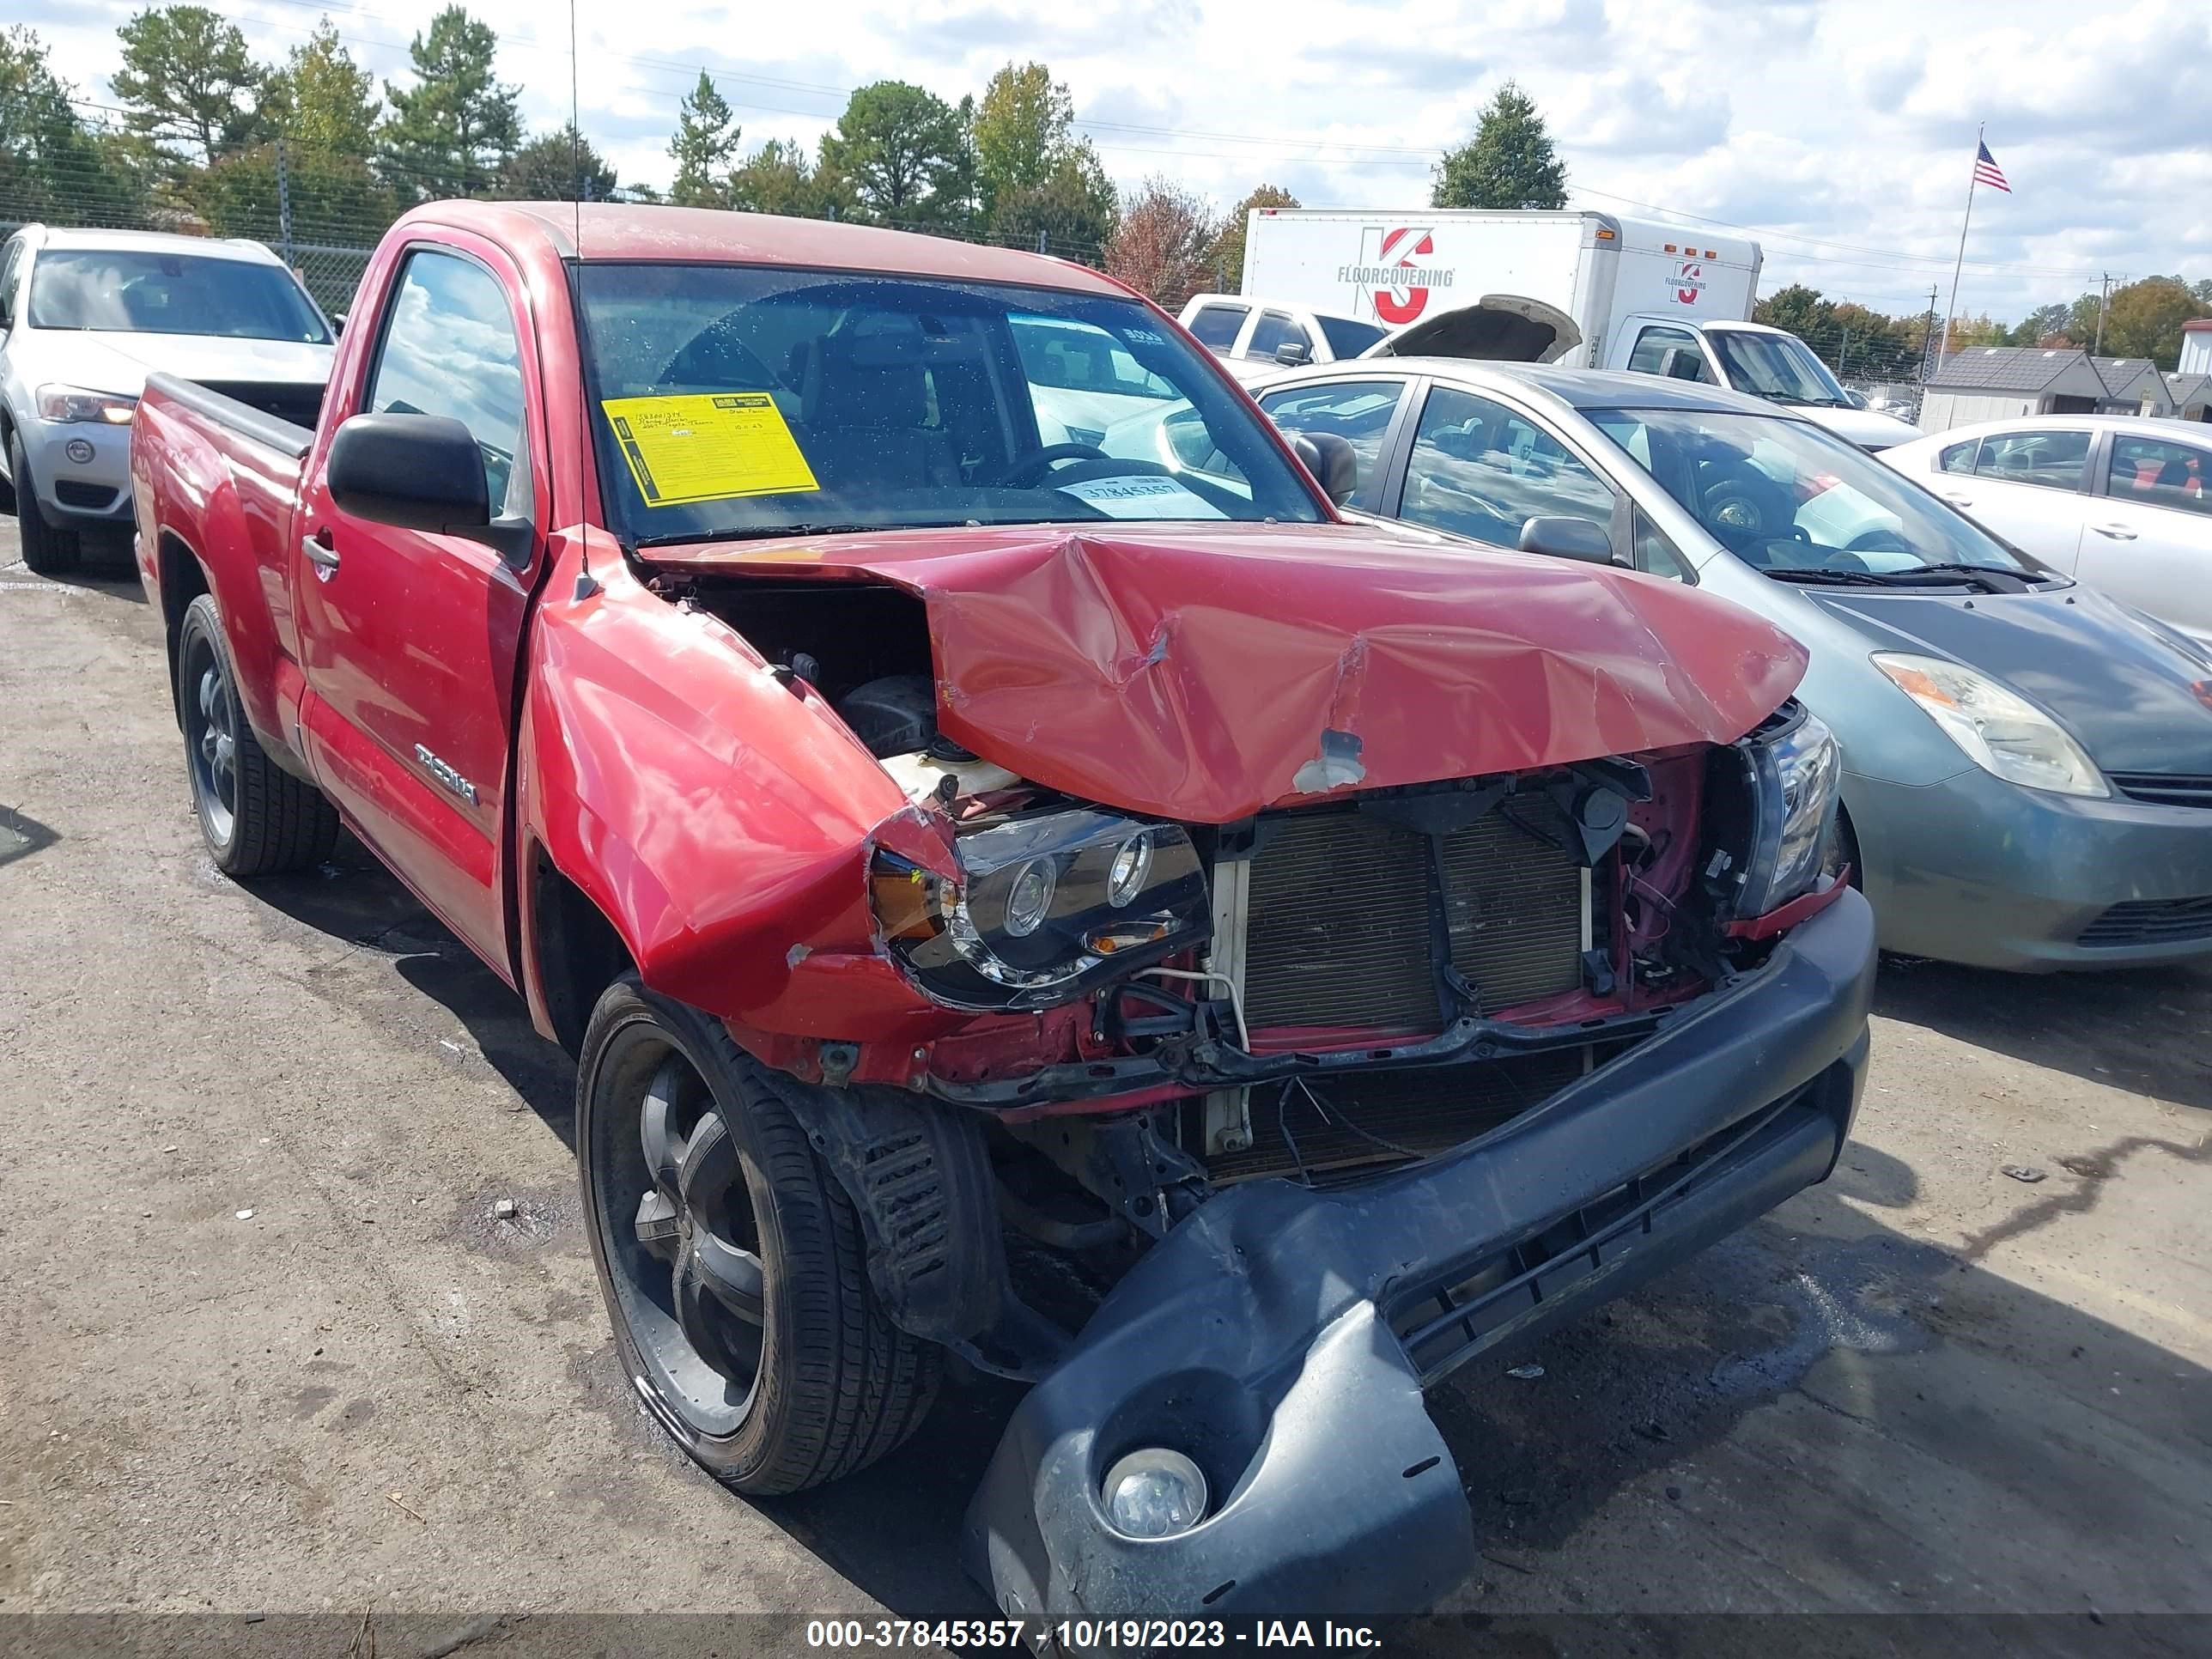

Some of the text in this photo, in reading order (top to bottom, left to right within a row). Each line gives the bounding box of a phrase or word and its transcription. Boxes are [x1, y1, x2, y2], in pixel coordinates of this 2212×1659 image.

[1338, 265, 1454, 288] FLOORCOVERING
[1665, 276, 1707, 290] FLOORCOVERING
[1084, 485, 1176, 498] 37845357
[414, 741, 480, 806] TACOMA
